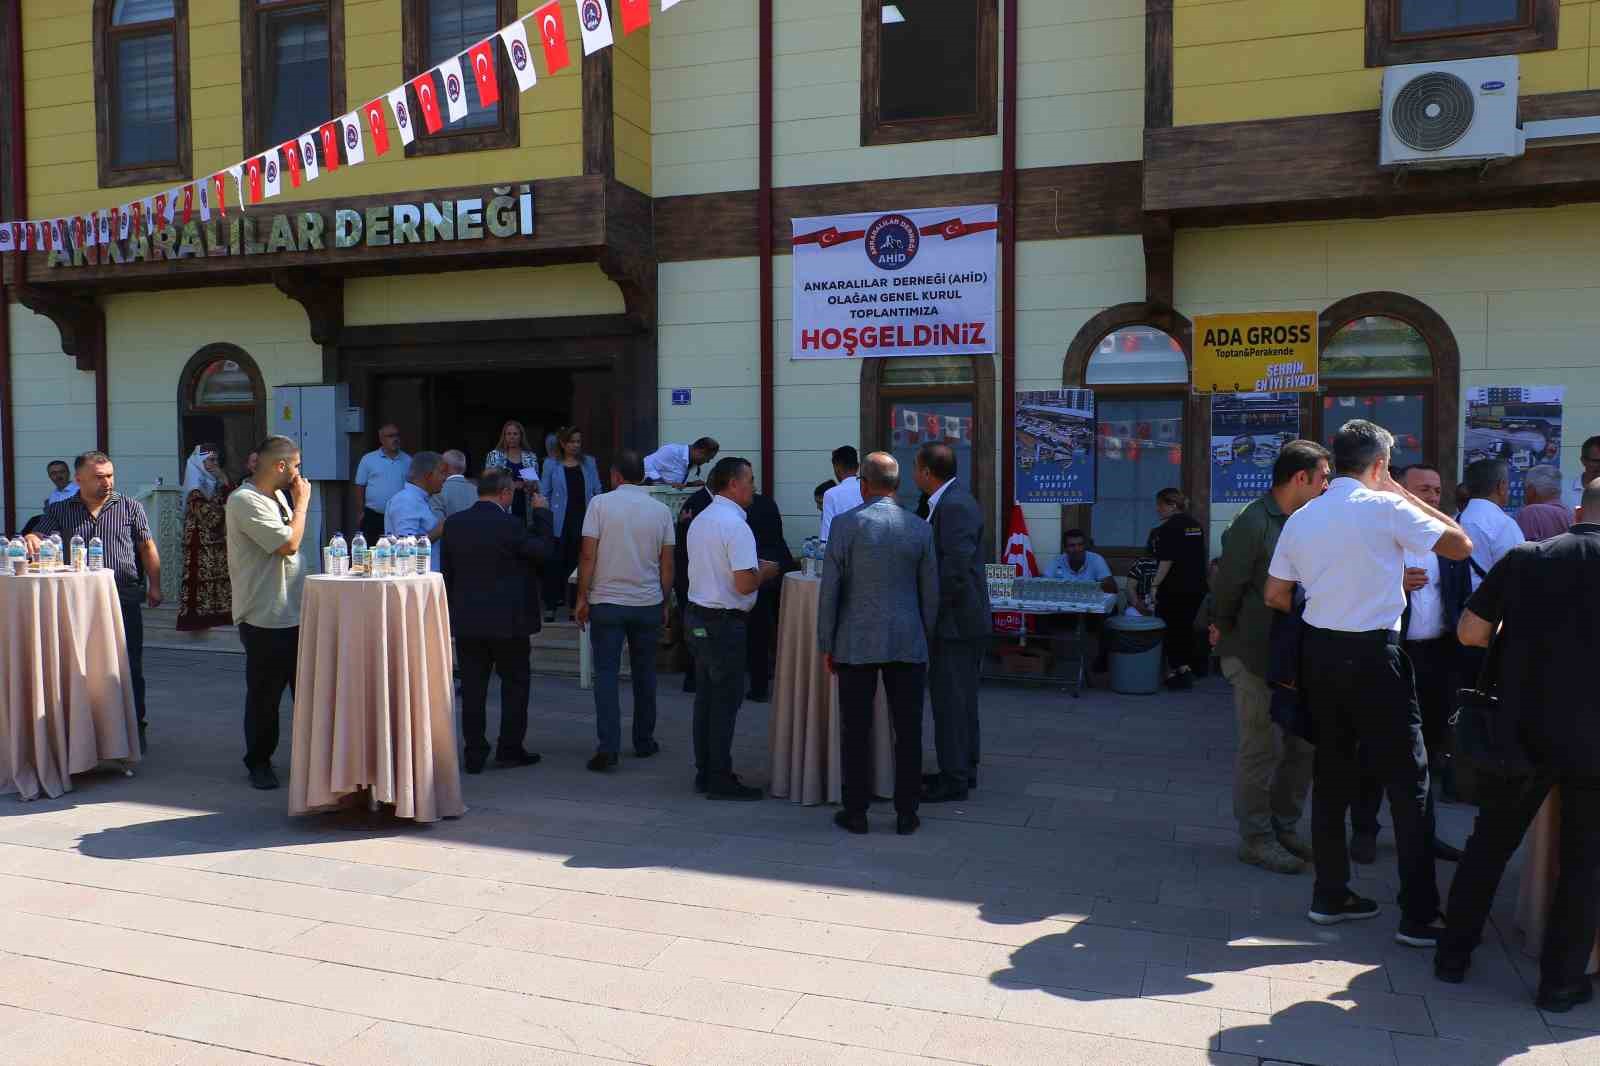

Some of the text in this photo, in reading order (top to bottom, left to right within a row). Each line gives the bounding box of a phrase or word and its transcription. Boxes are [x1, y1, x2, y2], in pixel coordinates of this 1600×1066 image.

[336, 184, 533, 248] DERNEĞİ
[804, 271, 988, 291] ANKARALILAR DERNEĞİ (AHİD)
[827, 290, 962, 305] OLAĞAN GENEL KURUL
[850, 306, 938, 319] TOPLANTIMIZA
[1203, 325, 1311, 346] ADA GROSS
[1215, 346, 1295, 359] Toptan&Perakende
